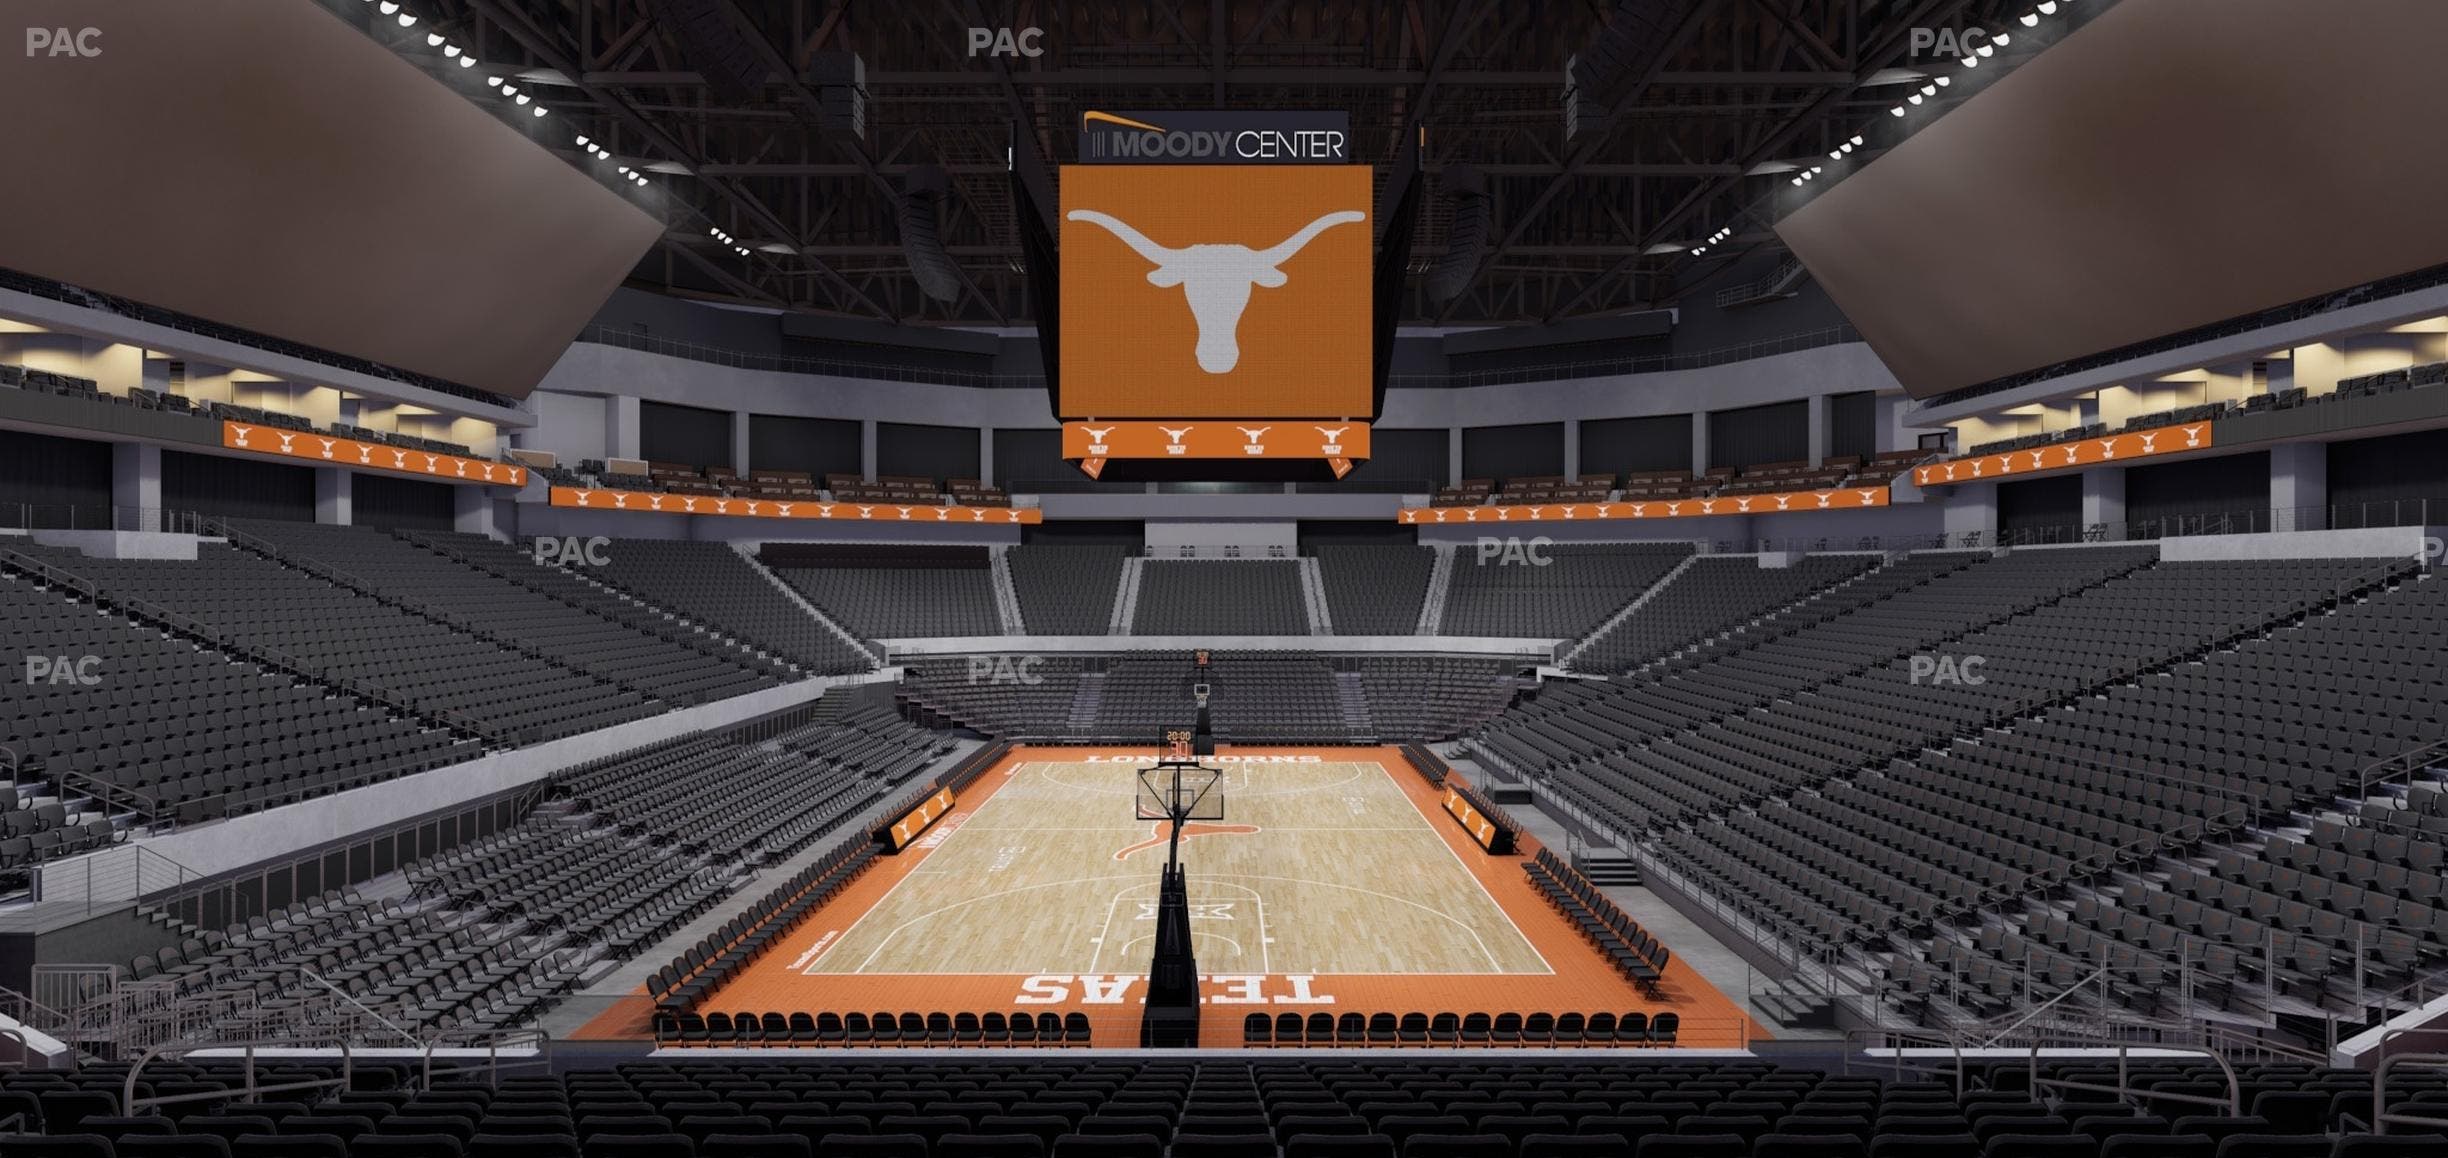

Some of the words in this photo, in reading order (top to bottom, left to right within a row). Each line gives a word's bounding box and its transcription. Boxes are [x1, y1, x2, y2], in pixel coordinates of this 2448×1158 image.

[1113, 131, 1231, 157] MOODY
[1236, 130, 1344, 158] CENTER
[1167, 731, 1191, 741] 20:00
[1014, 975, 1335, 1004] TEAS
